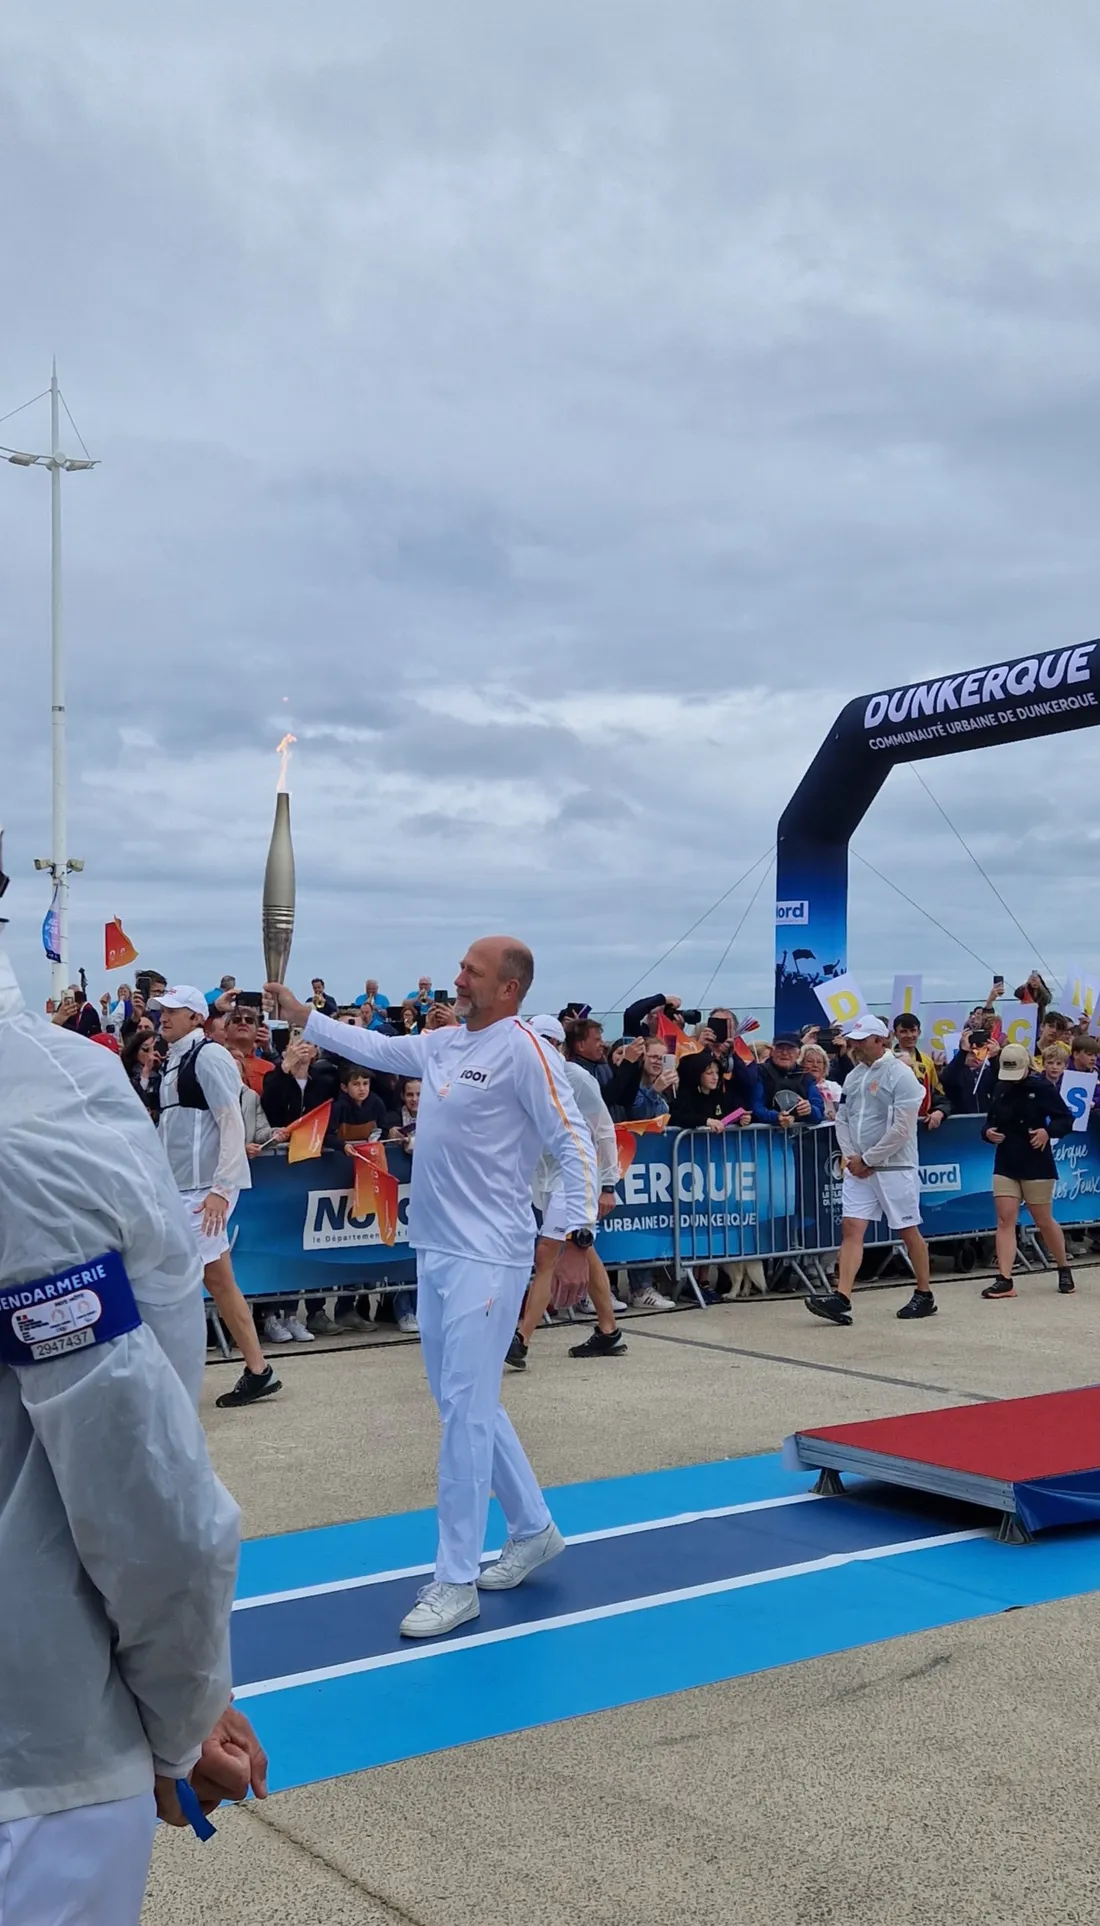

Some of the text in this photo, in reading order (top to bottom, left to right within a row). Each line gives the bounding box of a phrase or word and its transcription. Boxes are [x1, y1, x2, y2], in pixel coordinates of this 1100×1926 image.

[864, 644, 1097, 729] DUNKERQUE
[869, 692, 1099, 750] COMMUNAUTÉ URBAINE DE DUNKERQUE
[827, 990, 860, 1023] D
[930, 1018, 957, 1050] S
[1007, 1019, 1032, 1049] C
[1067, 1087, 1088, 1118] S
[325, 1232, 380, 1243] Départemen
[603, 1215, 658, 1233] URBAINE
[680, 1212, 757, 1229] DUNKERQUE
[0, 1264, 107, 1312] ENDARMERIE
[37, 1331, 89, 1356] 2947437
